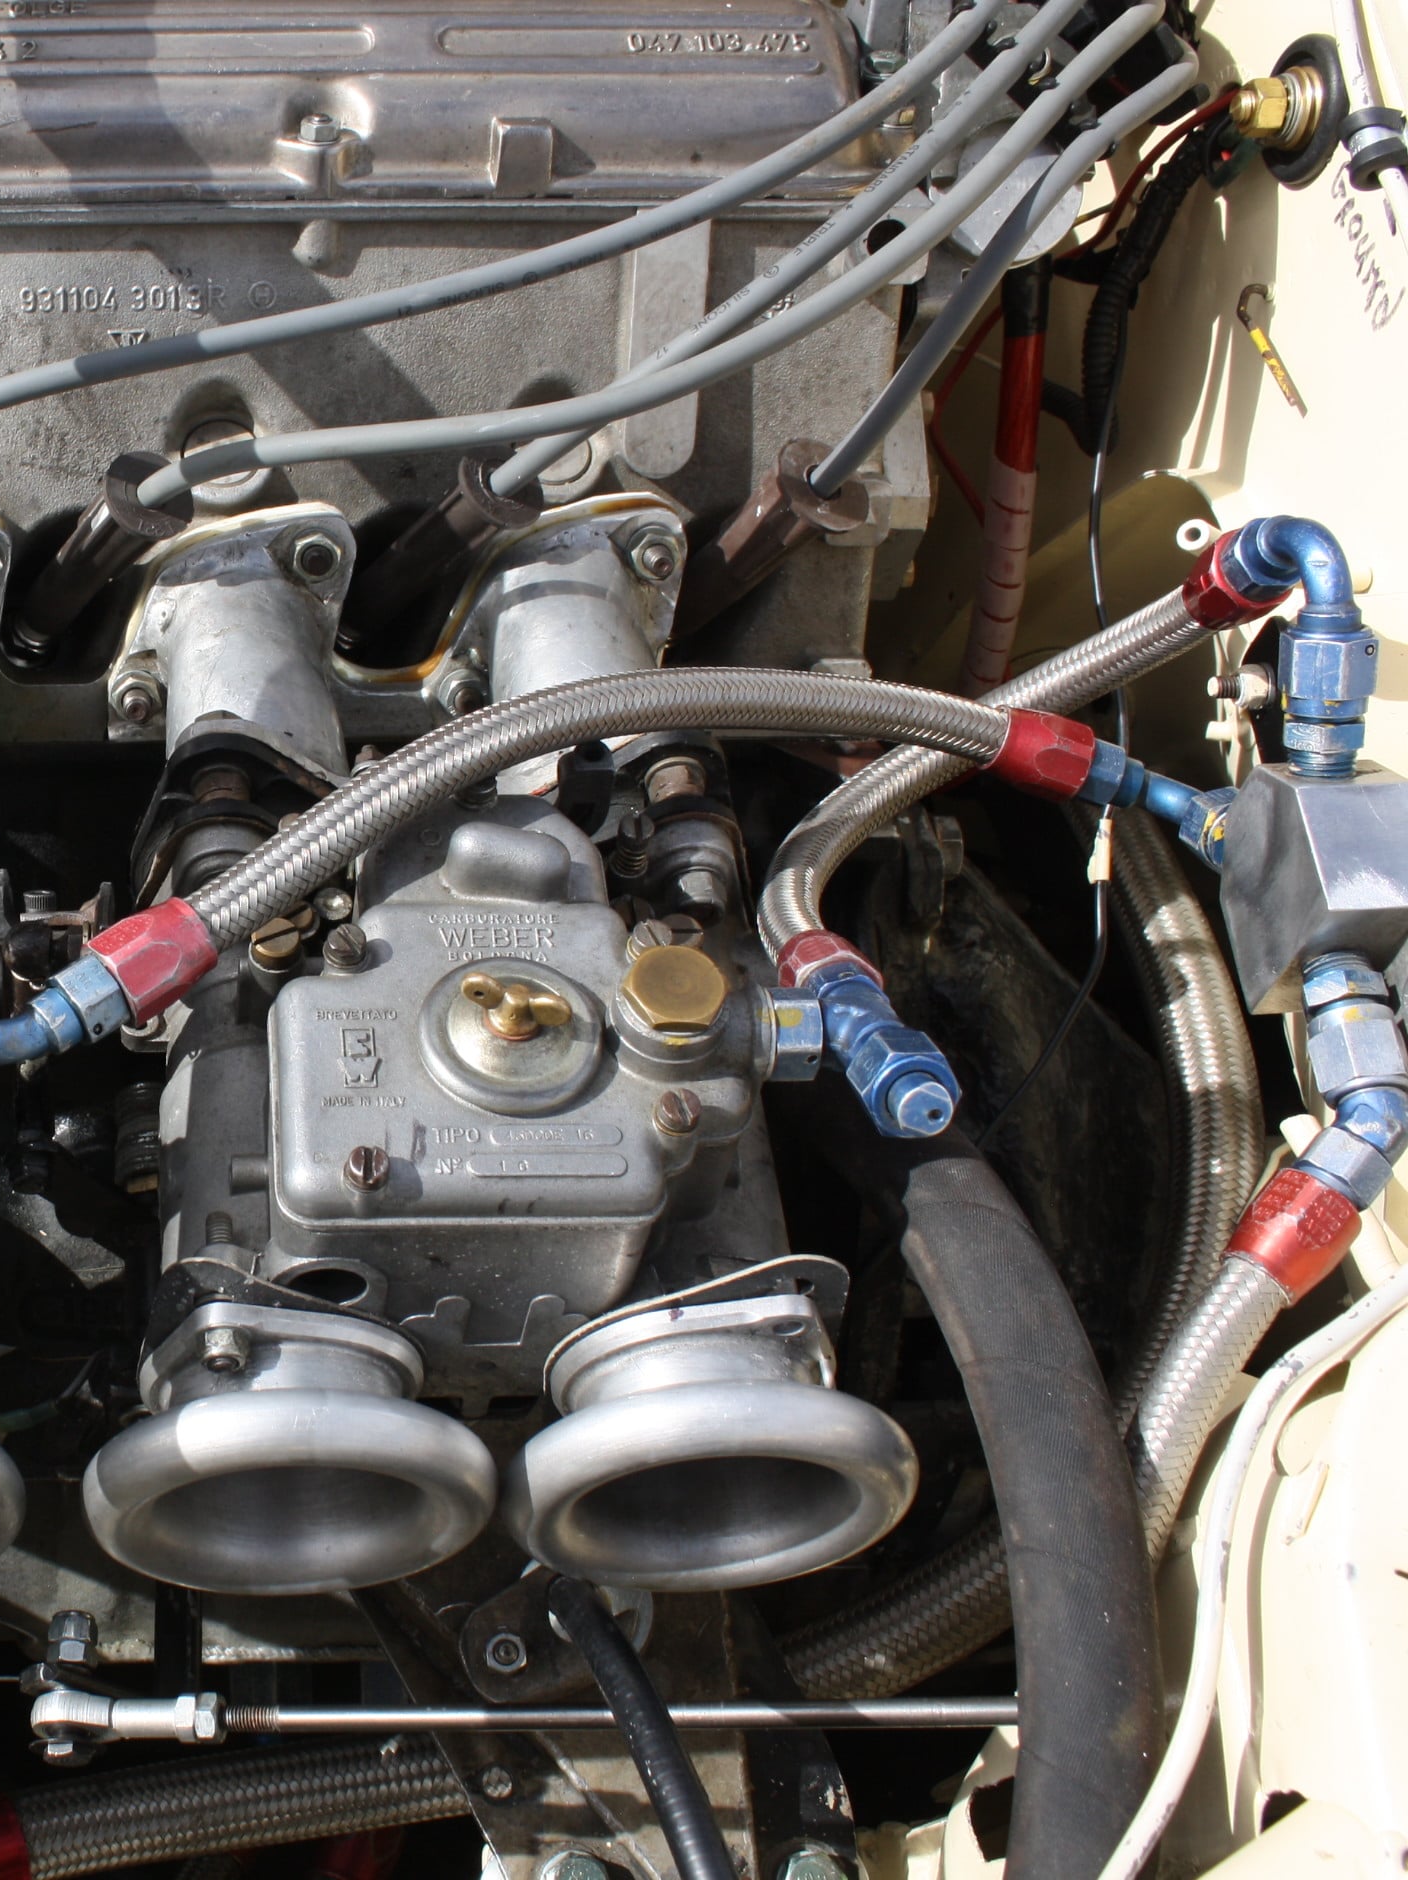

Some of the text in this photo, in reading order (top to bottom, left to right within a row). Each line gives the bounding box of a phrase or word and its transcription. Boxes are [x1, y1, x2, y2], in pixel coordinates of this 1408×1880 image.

[863, 143, 920, 194] STANDARD
[792, 219, 836, 257] TRIPLE
[19, 286, 118, 313] 931104
[689, 286, 751, 336] SILICONE
[428, 913, 561, 925] CARBURATORE
[438, 926, 557, 949] WEBER
[320, 1096, 406, 1107] MADE IN ITALY
[432, 1127, 481, 1144] TIPO
